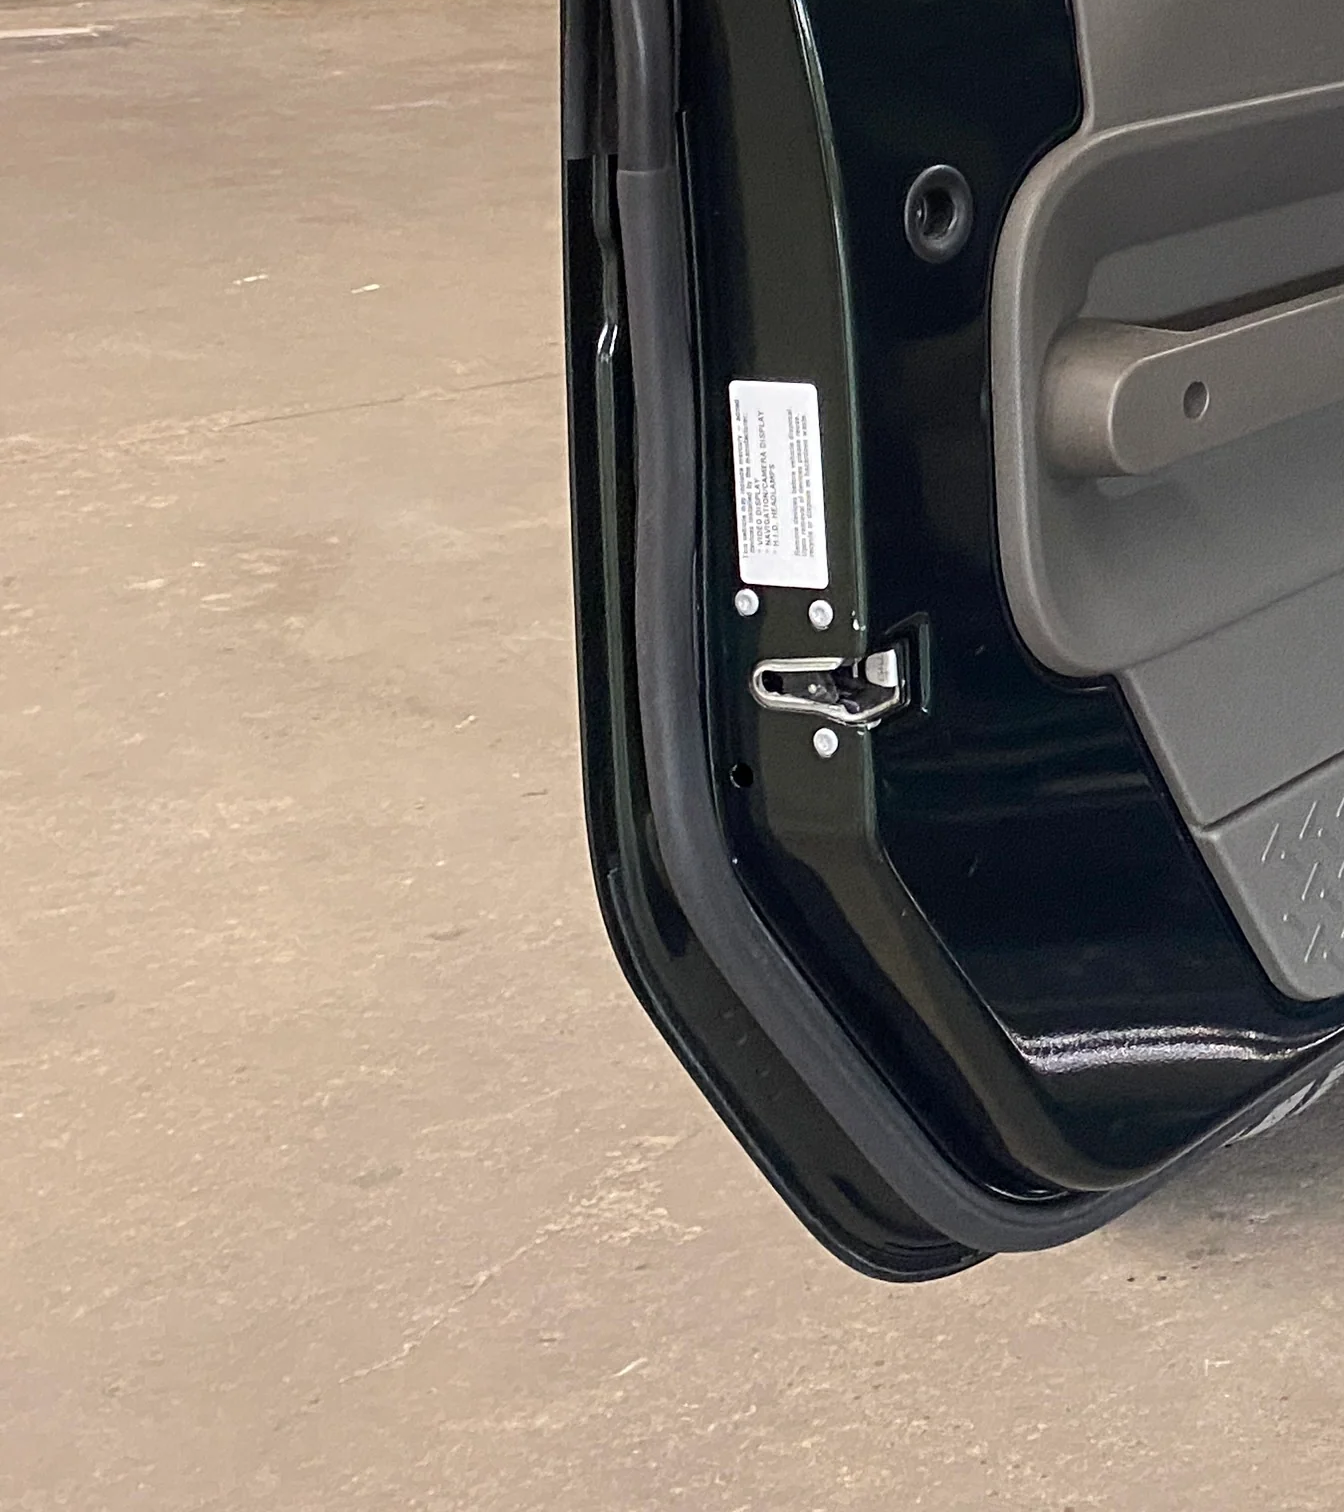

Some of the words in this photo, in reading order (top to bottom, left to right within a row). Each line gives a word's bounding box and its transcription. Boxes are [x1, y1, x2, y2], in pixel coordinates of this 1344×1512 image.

[758, 411, 766, 448] DISPLAY
[760, 452, 770, 545] NAVIGATION/CAMERA
[769, 464, 777, 518] HEADLAMPS
